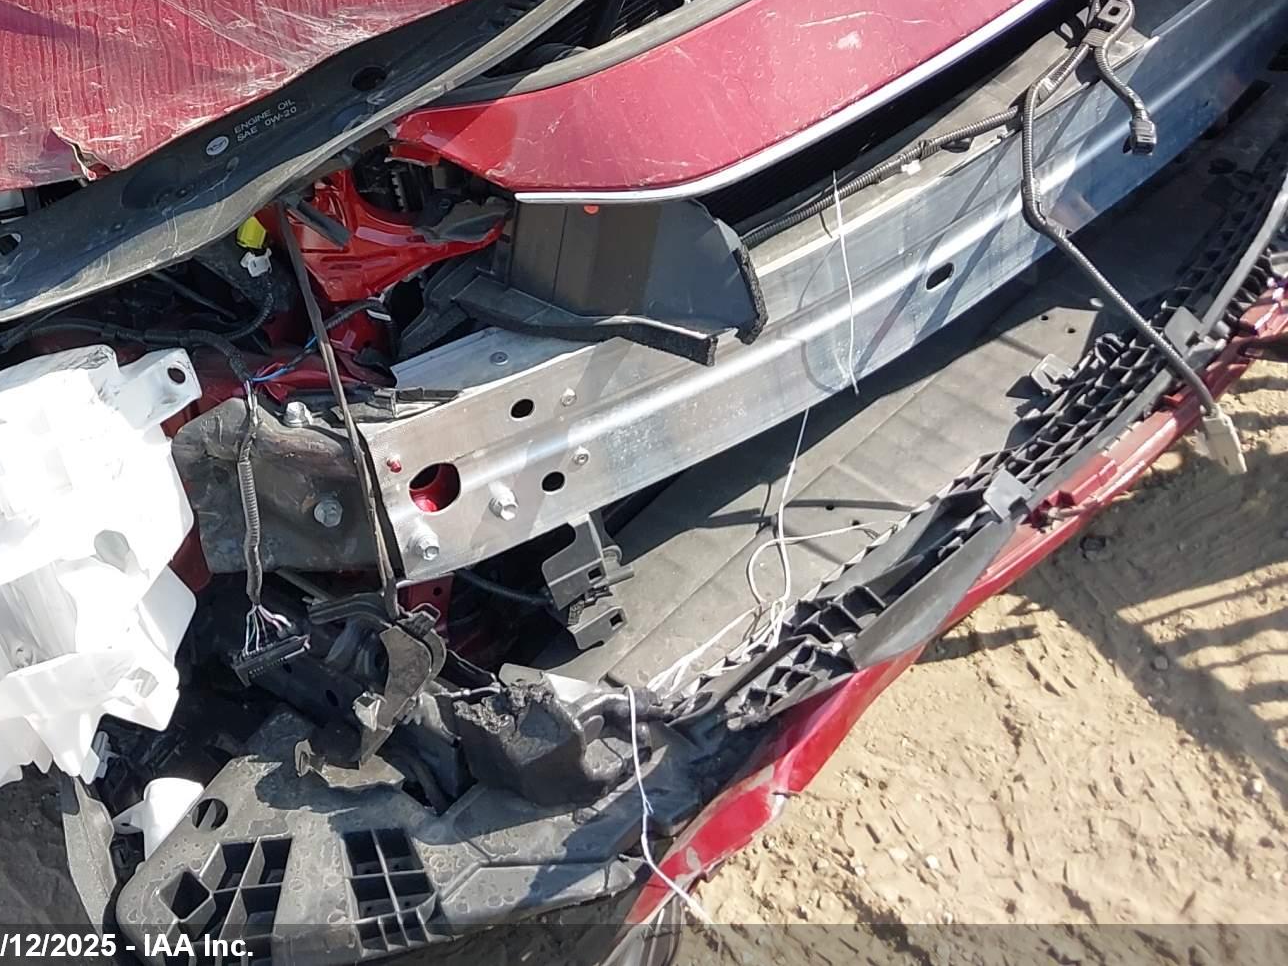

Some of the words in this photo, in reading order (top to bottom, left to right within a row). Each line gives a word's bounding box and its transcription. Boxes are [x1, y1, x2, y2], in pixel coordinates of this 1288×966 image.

[234, 109, 272, 134] ENGINE
[277, 99, 296, 111] OIL
[237, 125, 258, 142] SAE
[264, 106, 297, 126] 0W-20
